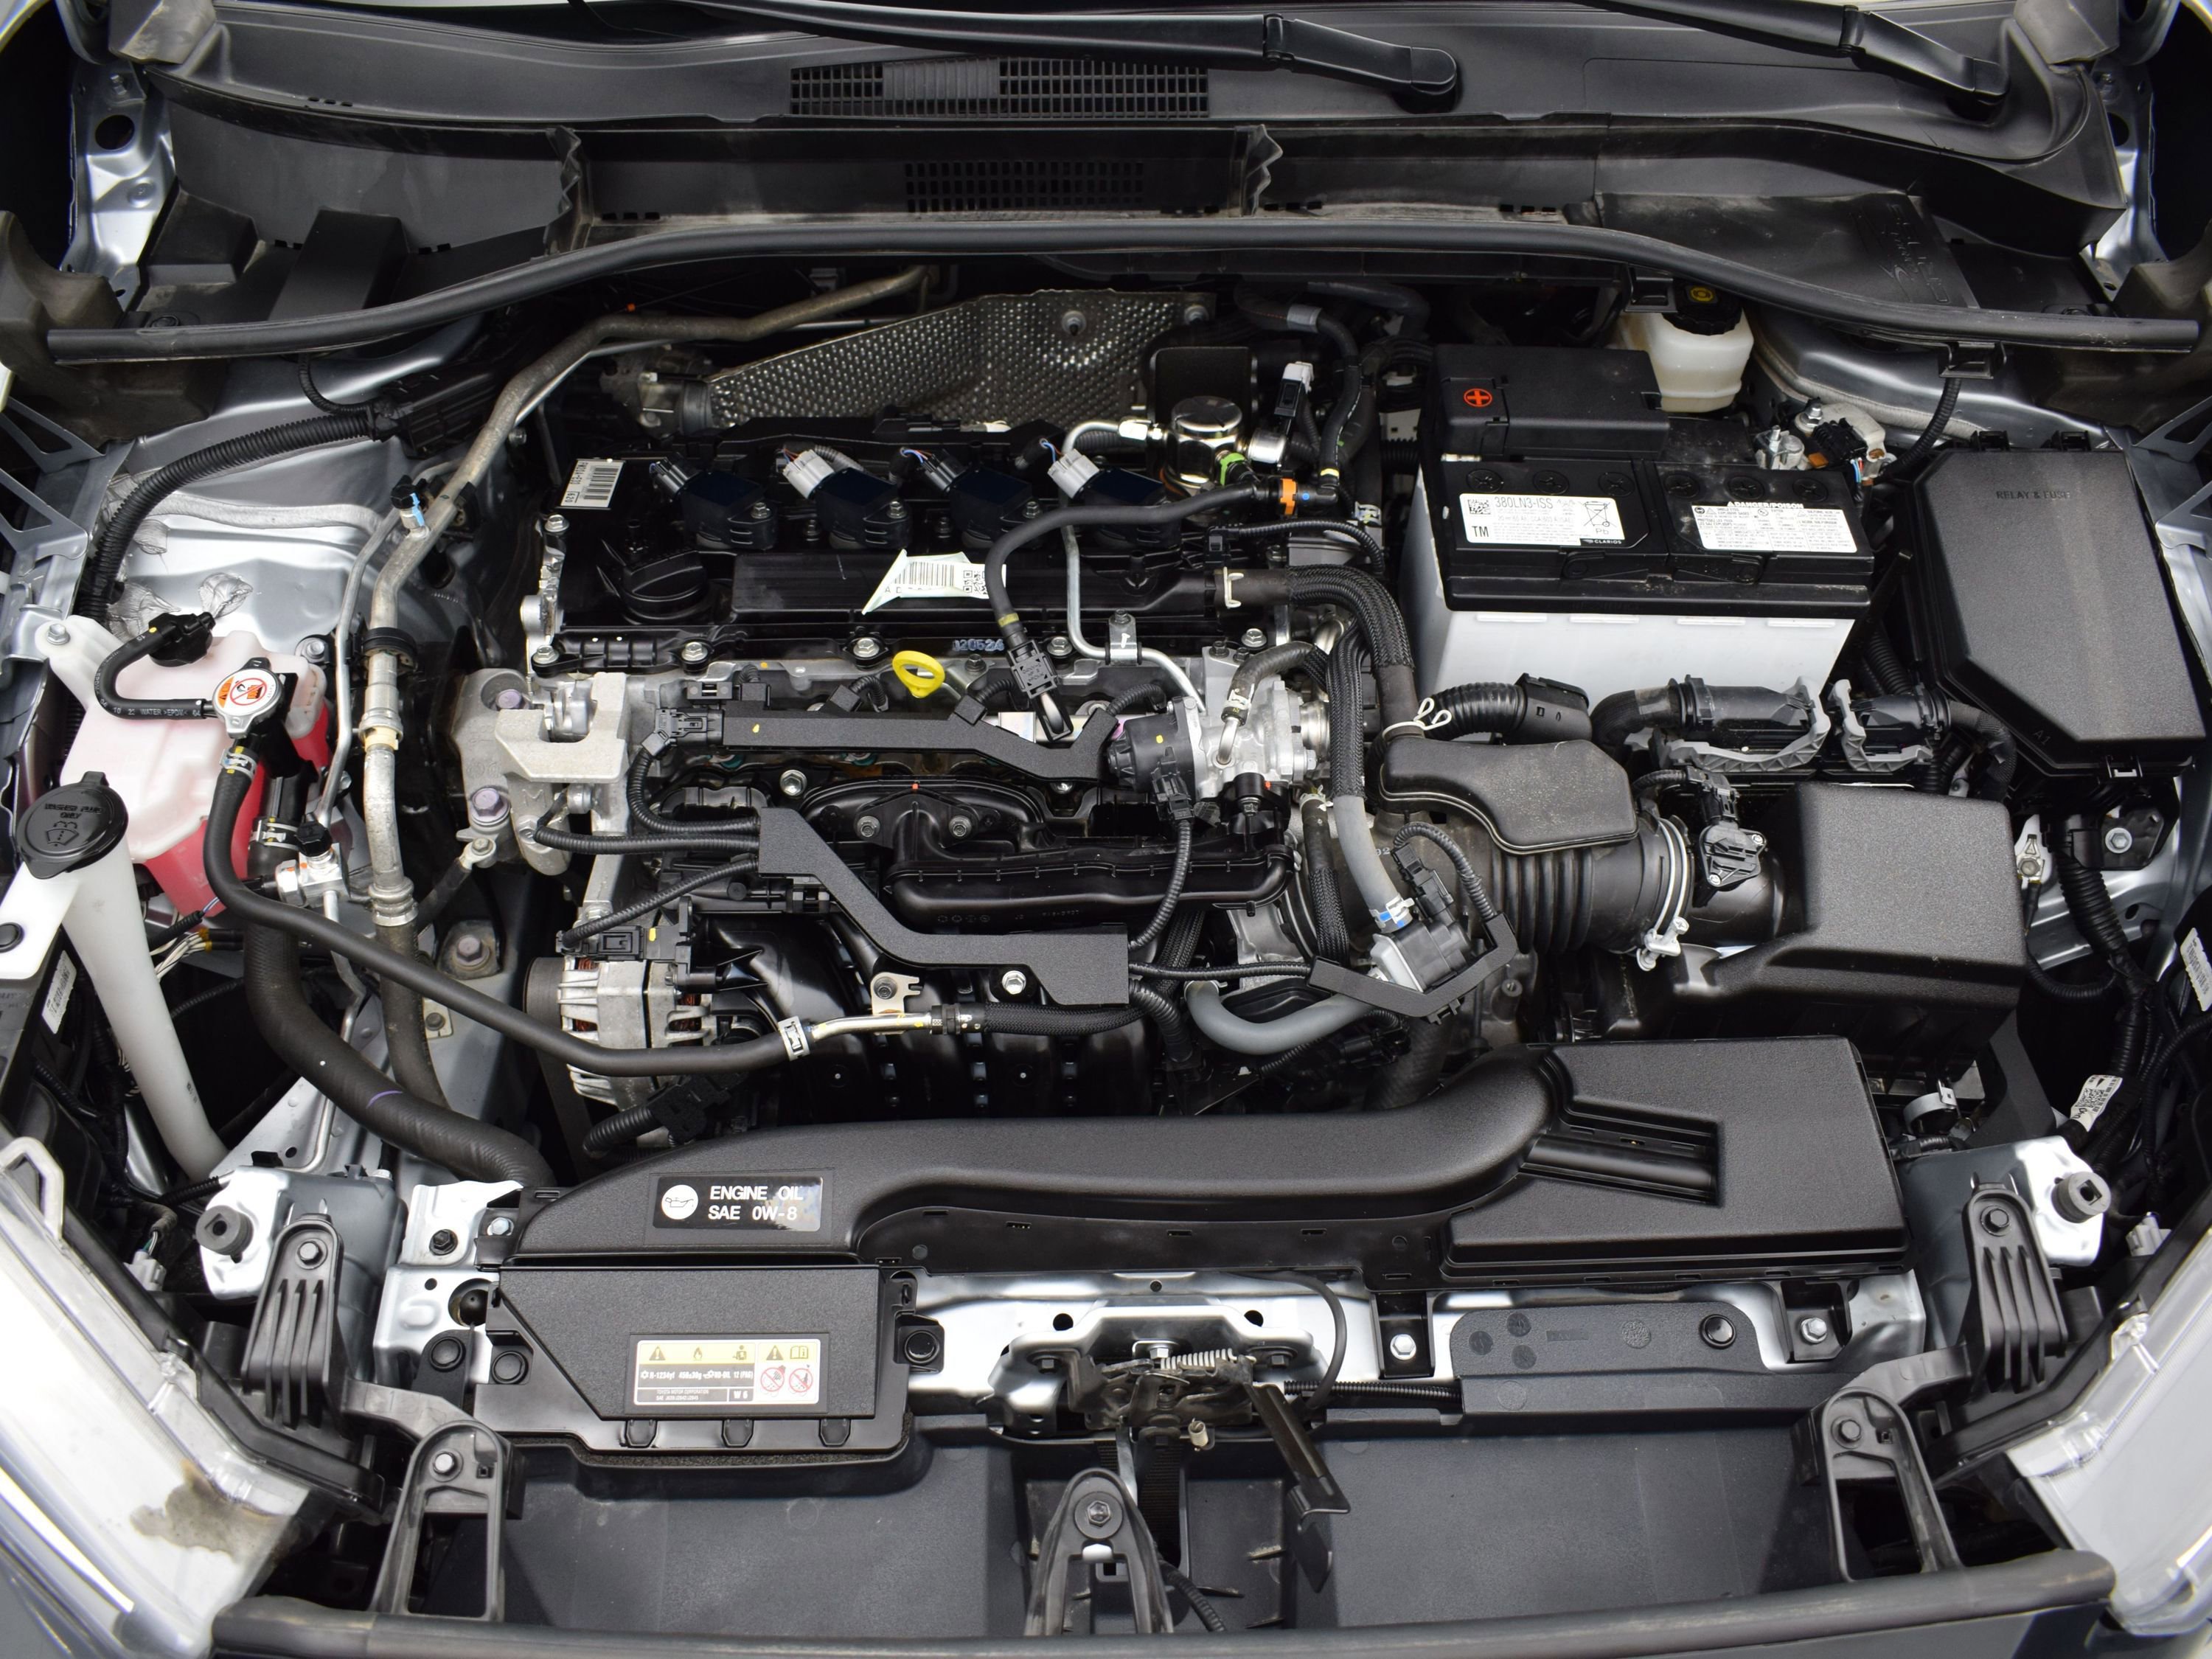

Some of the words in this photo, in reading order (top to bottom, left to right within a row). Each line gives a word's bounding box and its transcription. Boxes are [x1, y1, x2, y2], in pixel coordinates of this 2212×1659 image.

[1996, 490, 2030, 499] RELAY
[1495, 497, 1554, 509] 380LN3-ISS
[1472, 526, 1489, 538] TM
[709, 1185, 768, 1201] ENGINE
[777, 1186, 804, 1200] OIL
[708, 1205, 741, 1220] SAE
[752, 1206, 798, 1221] 0W-8
